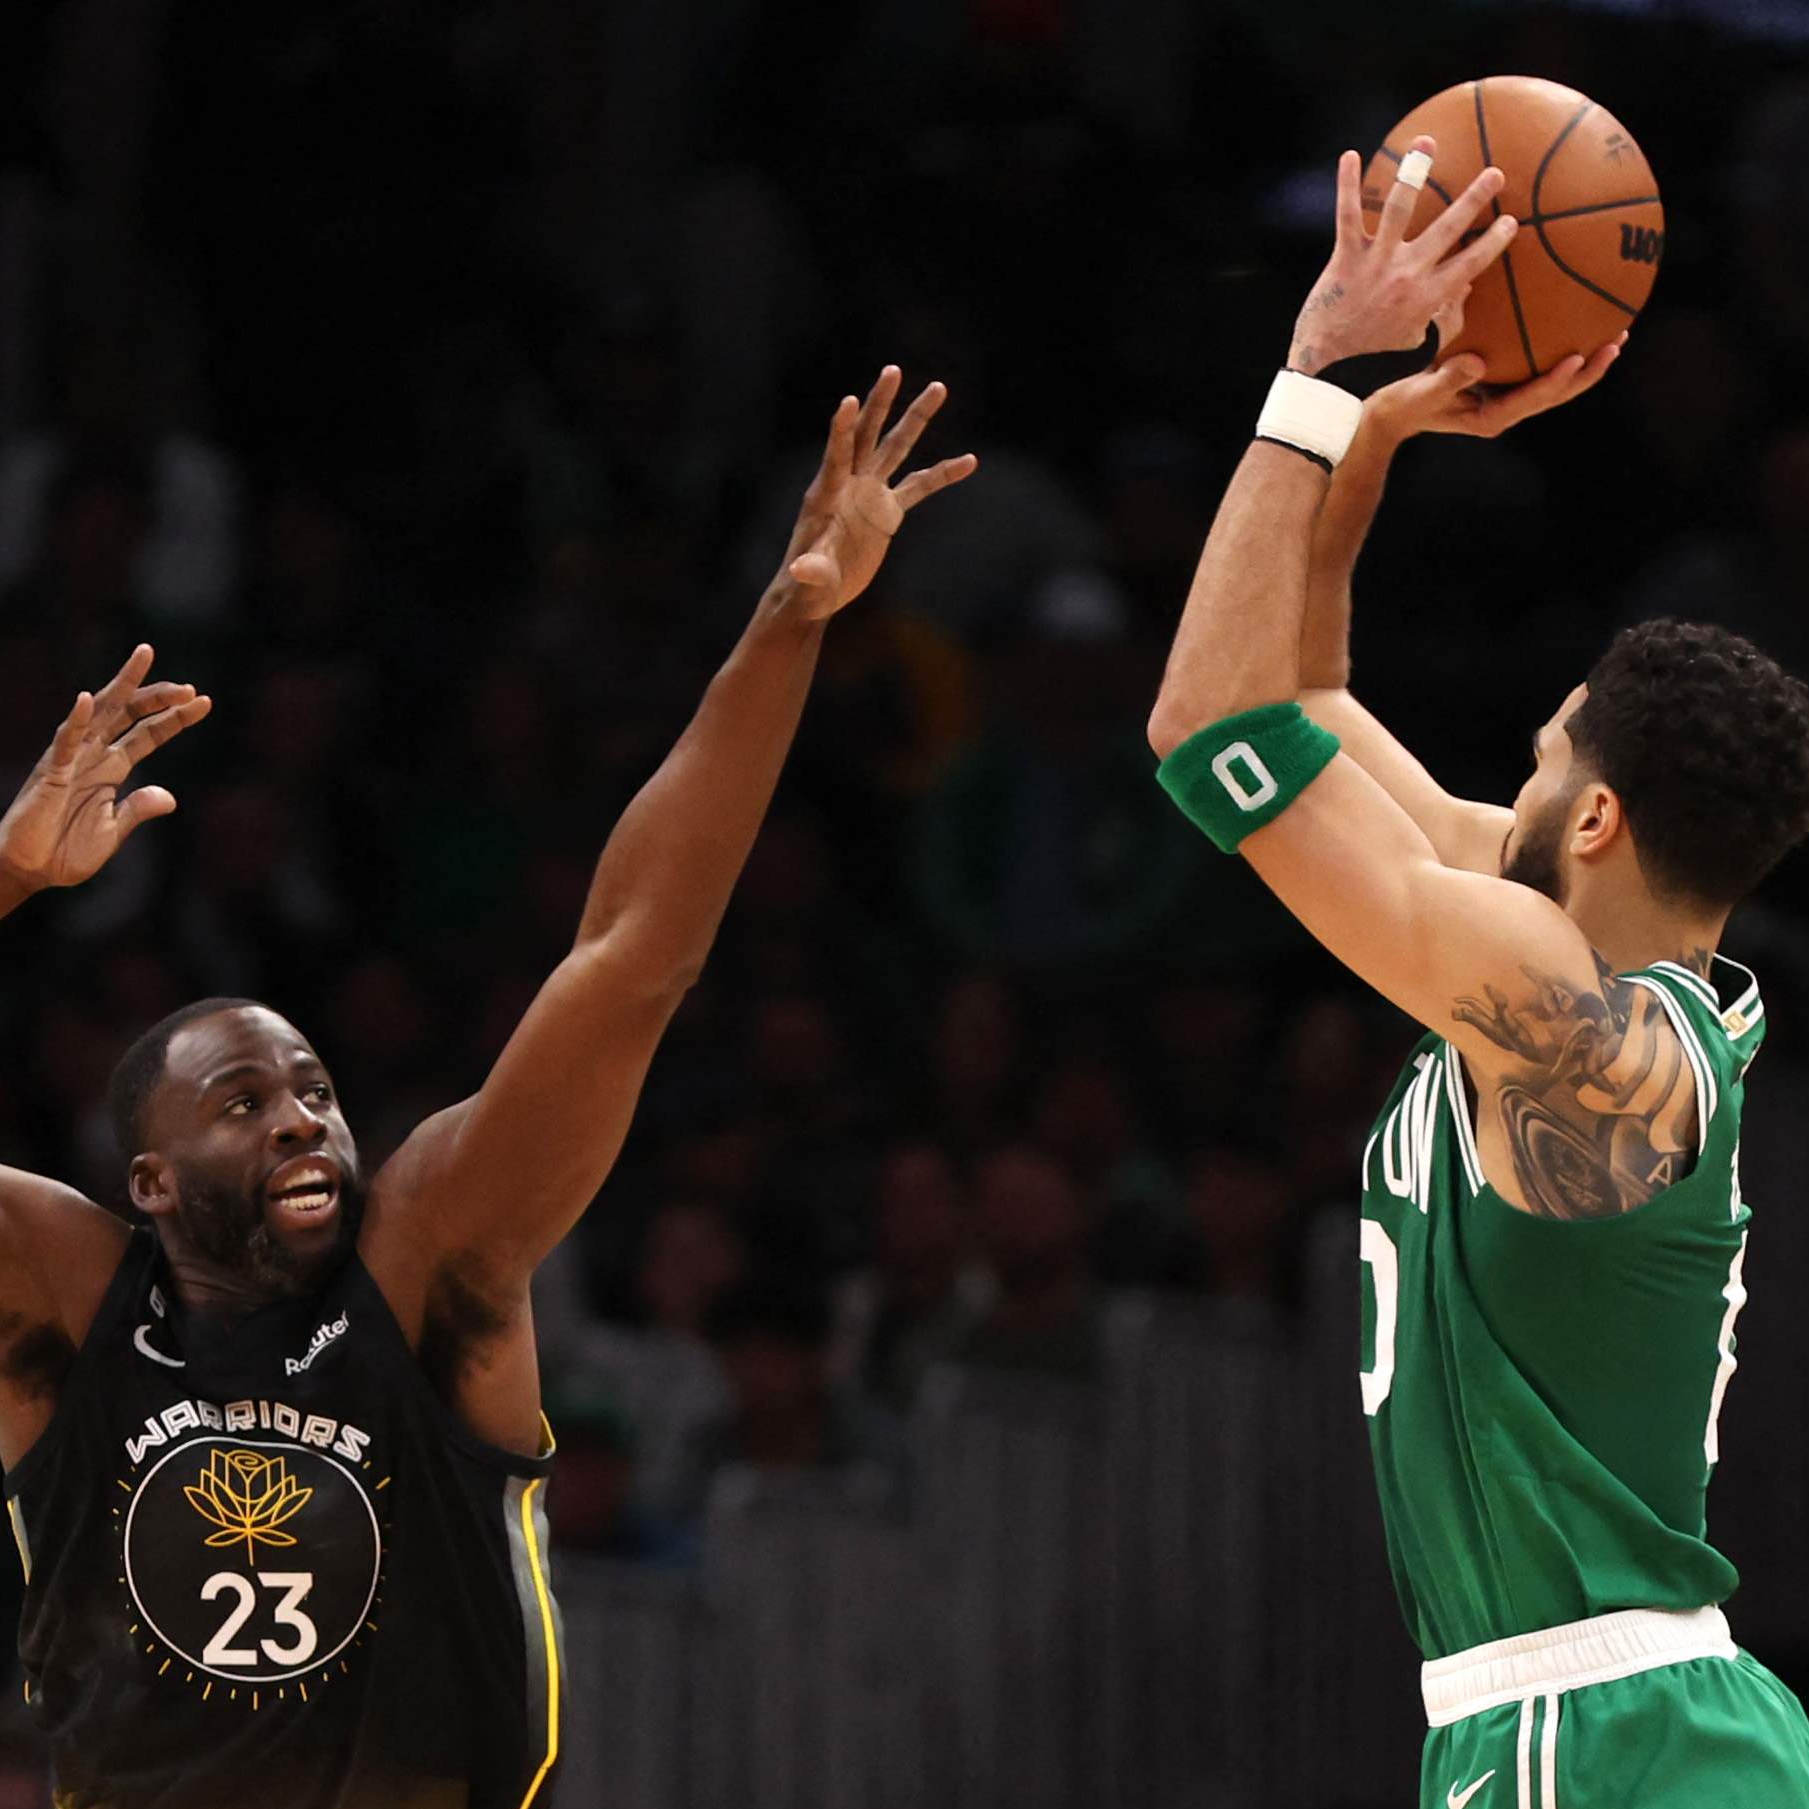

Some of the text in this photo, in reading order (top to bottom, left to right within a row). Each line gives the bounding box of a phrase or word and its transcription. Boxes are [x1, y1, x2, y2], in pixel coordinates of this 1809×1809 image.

[1211, 741, 1279, 813] 0
[125, 1400, 371, 1464] WARRIORS
[199, 1571, 318, 1667] 23
